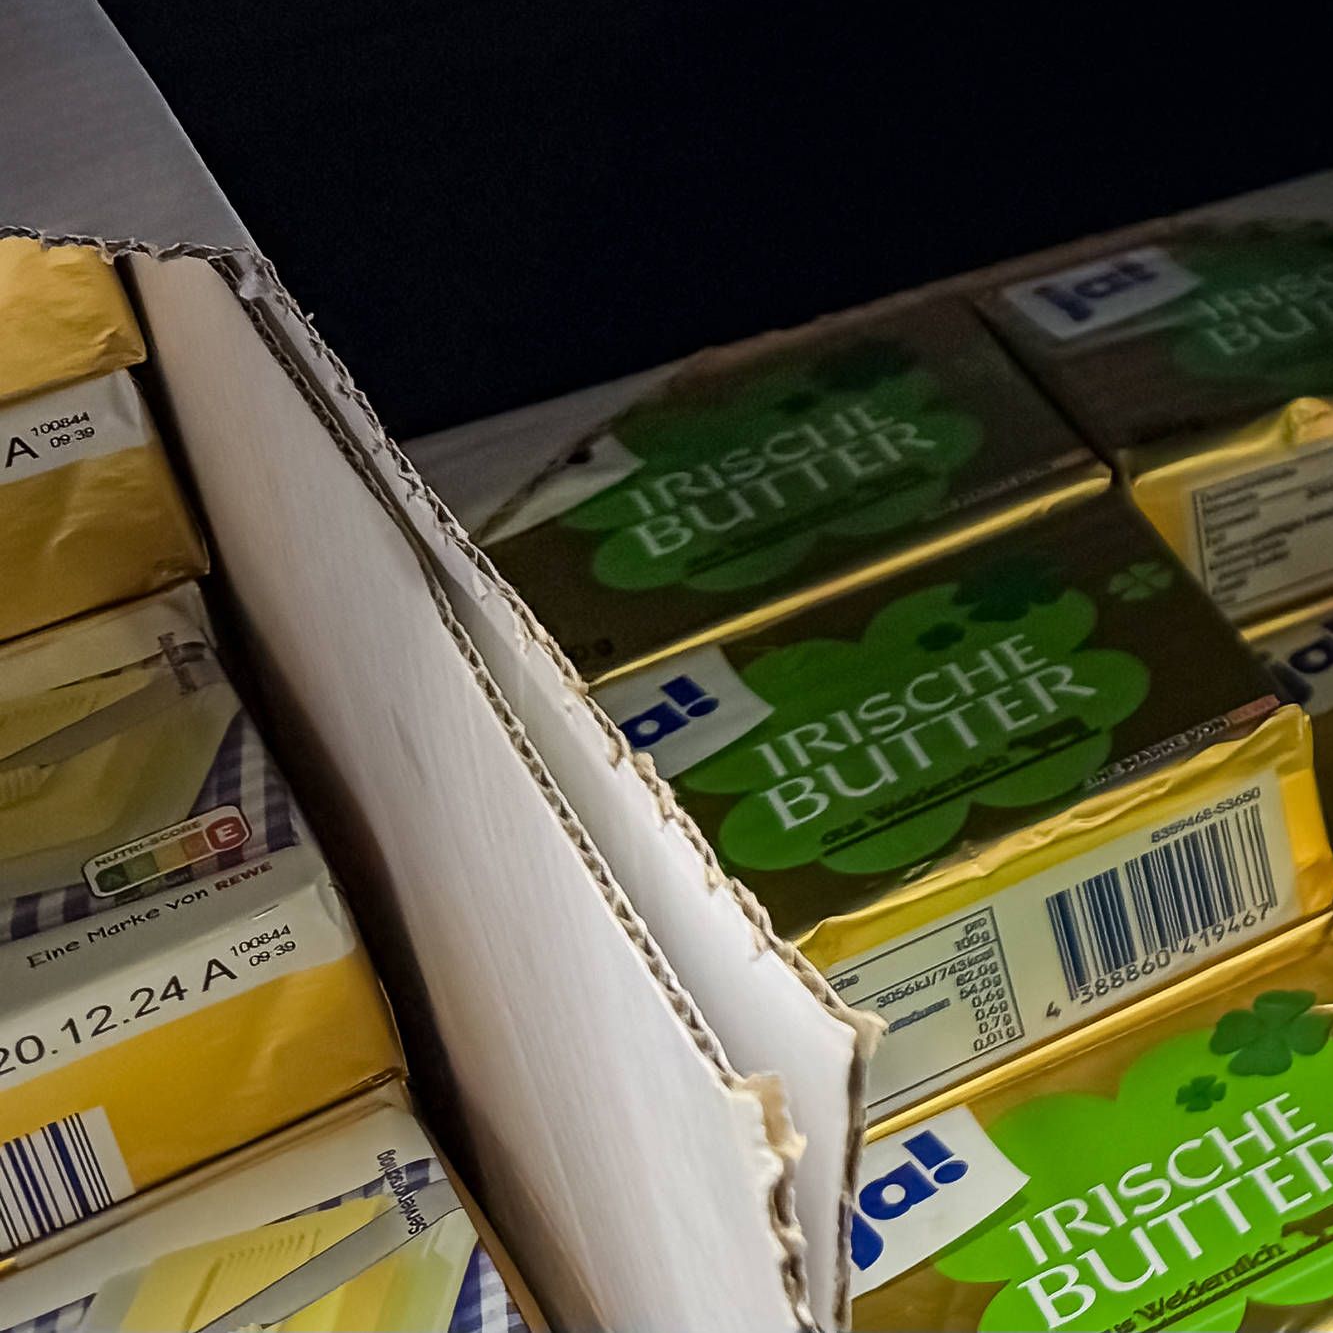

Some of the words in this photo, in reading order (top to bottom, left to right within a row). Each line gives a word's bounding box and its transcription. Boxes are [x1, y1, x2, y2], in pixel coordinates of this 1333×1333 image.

[5, 436, 40, 468] A
[628, 403, 895, 518] IRISCHE
[636, 419, 937, 558] BUTTER
[622, 675, 720, 751] a!
[754, 634, 1047, 778] IRISCHE
[762, 664, 1097, 831] BUTTER
[94, 820, 202, 868] NUTRI-SCORE
[216, 823, 240, 844] E
[26, 939, 81, 969] Eine
[87, 906, 161, 944] Marke
[165, 889, 209, 910] von
[214, 861, 273, 893] REWE
[1078, 950, 1170, 1005] 388860
[1181, 901, 1271, 955] 419467
[201, 958, 239, 993] A
[1009, 1092, 1317, 1265] IRISCHE
